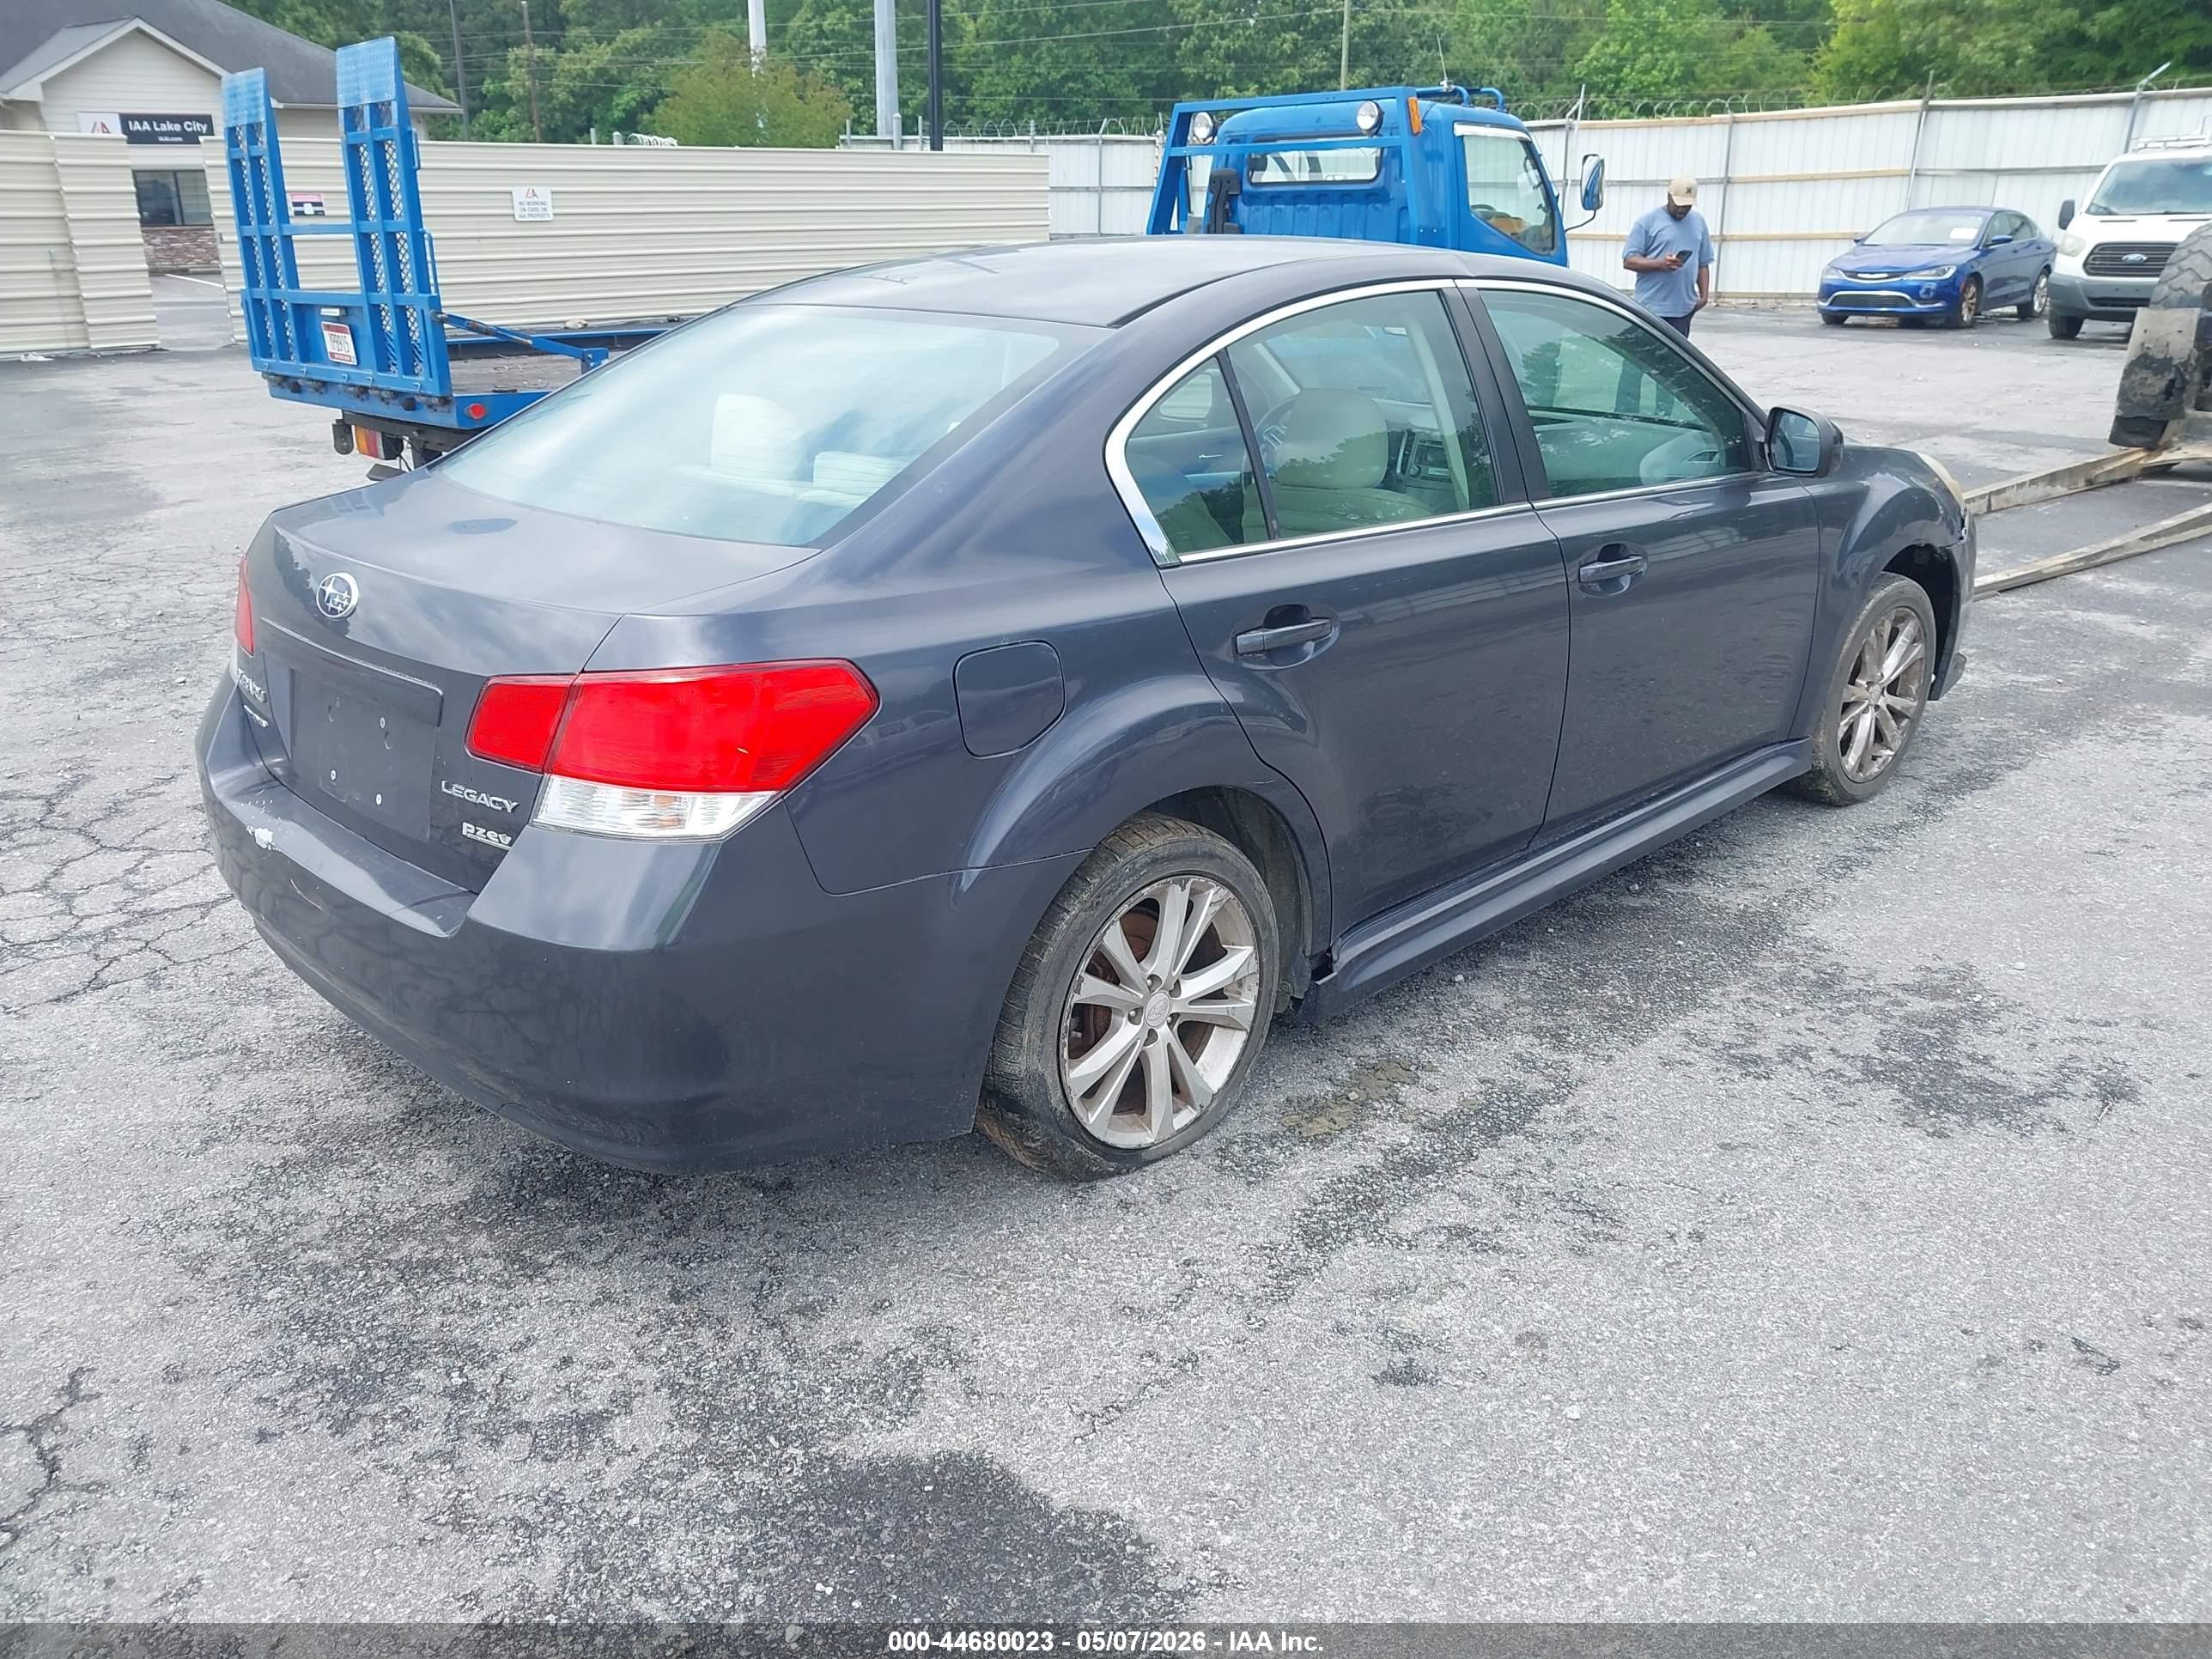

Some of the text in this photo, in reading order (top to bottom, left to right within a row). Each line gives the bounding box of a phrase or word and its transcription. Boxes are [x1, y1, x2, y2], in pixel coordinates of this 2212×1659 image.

[129, 120, 208, 133] IAA Lake City
[441, 780, 520, 813] LEGACY
